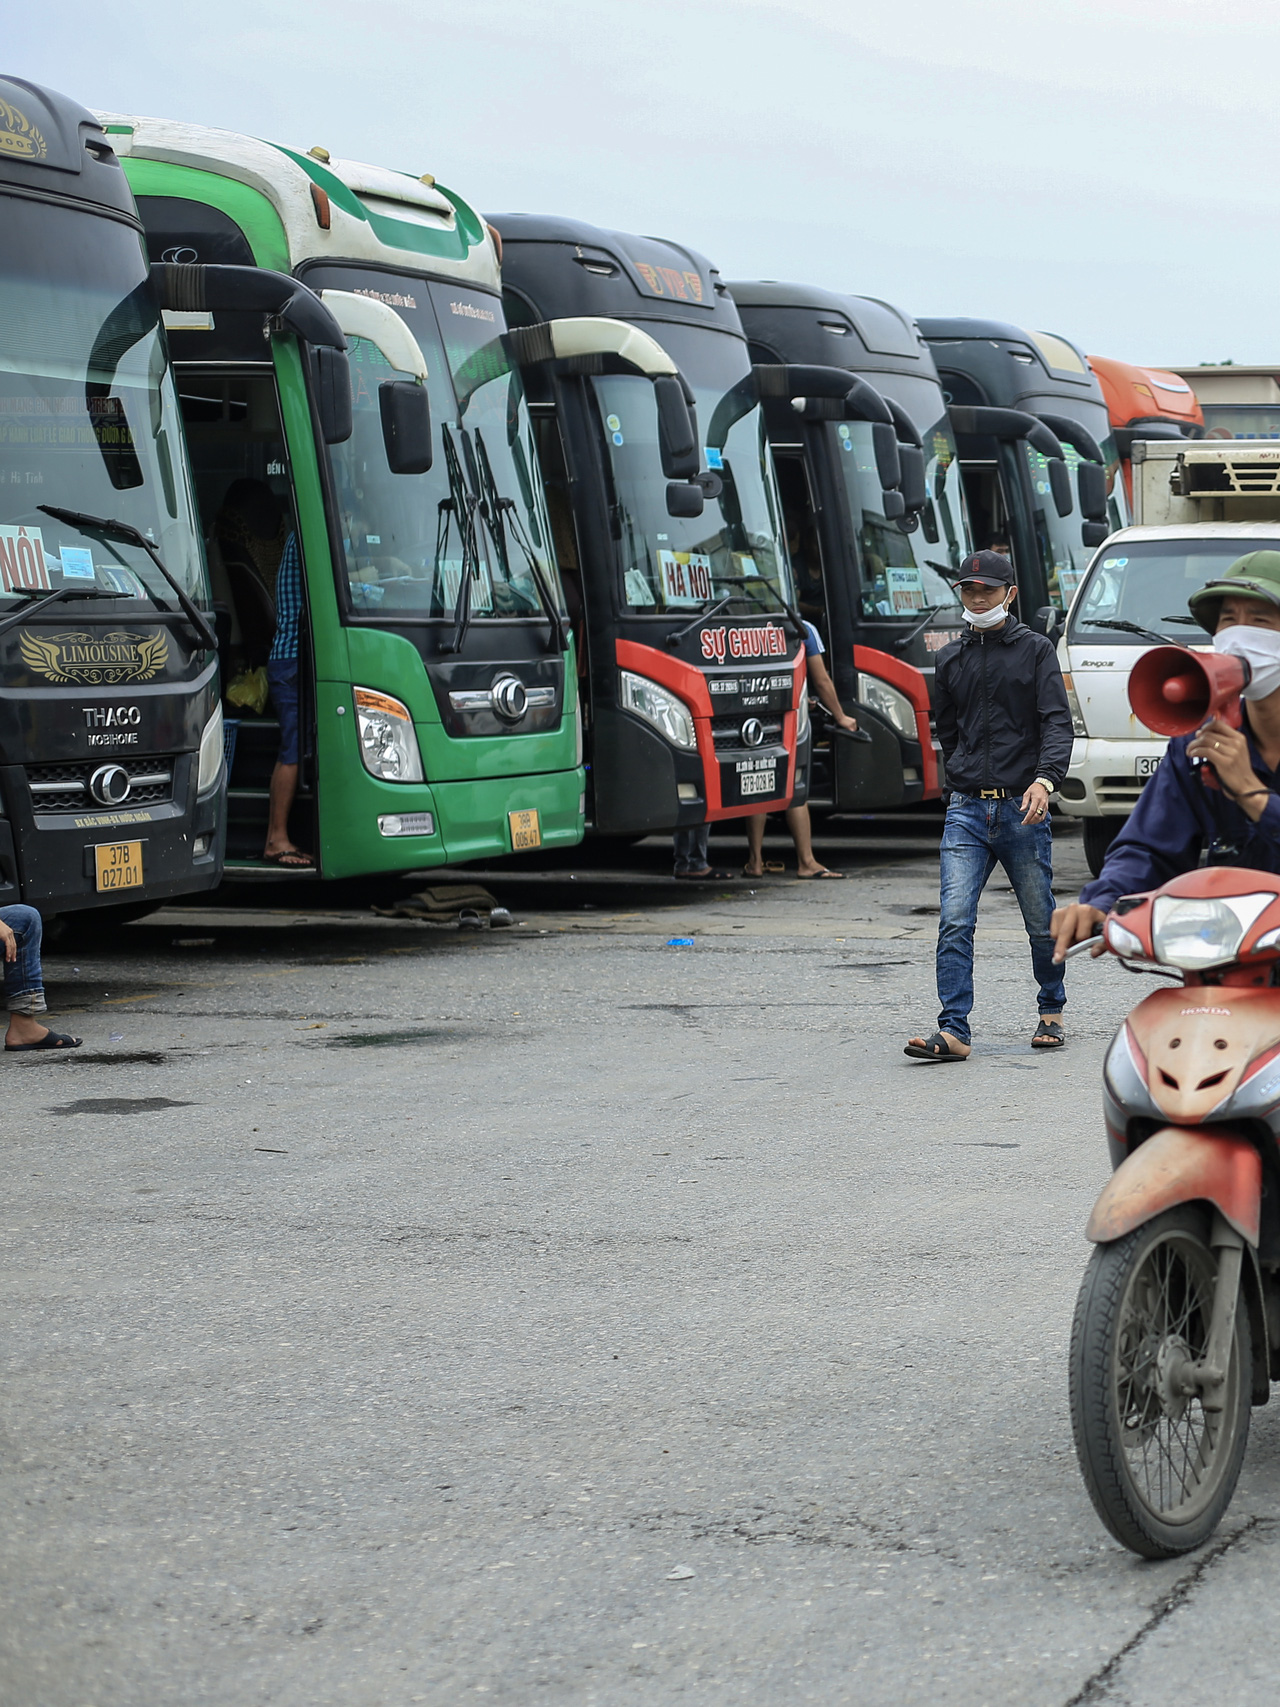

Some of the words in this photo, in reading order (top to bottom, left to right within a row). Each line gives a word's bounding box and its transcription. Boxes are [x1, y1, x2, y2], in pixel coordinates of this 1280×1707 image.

[61, 644, 139, 663] LIMOUSINE
[701, 626, 726, 665] SỰ
[82, 706, 141, 727] THACO
[88, 732, 138, 746] MOBIHOME
[110, 845, 130, 866] 37B
[102, 865, 138, 888] 027.01
[1180, 1006, 1232, 1016] HONDA
